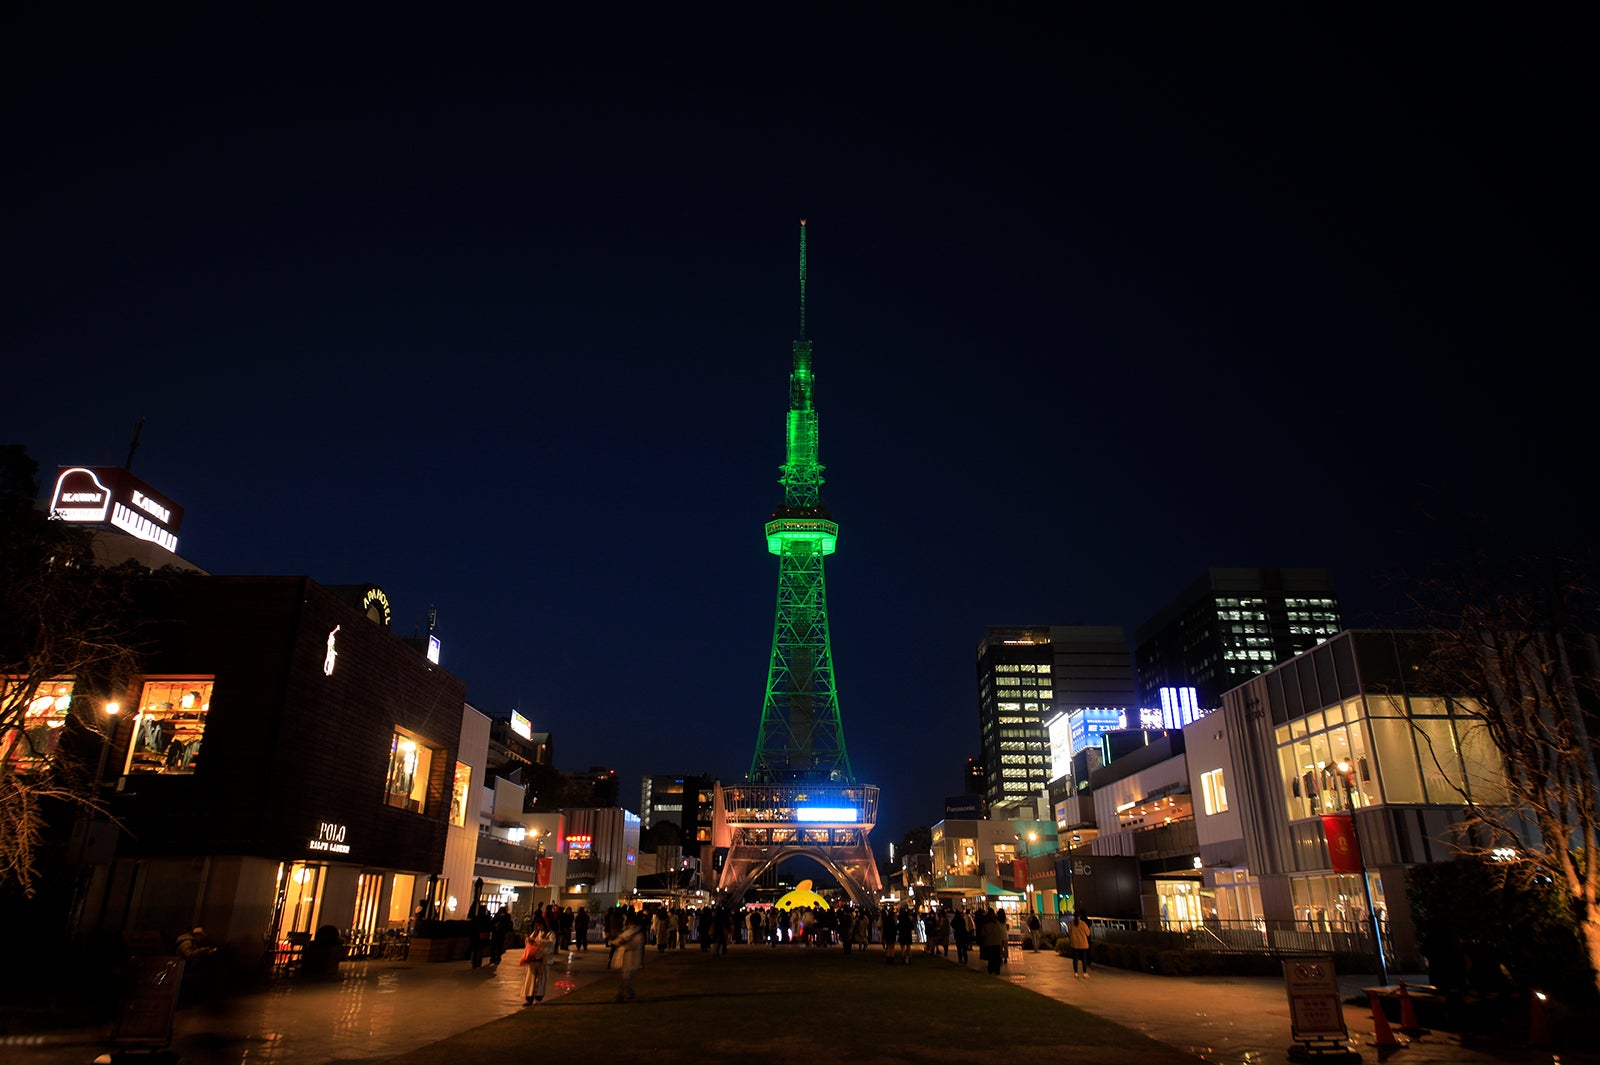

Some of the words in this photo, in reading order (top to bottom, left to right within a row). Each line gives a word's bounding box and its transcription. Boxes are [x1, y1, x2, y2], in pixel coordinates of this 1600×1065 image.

[61, 493, 102, 503] KAWAI
[132, 489, 171, 524] KAWAI
[319, 822, 346, 843] POLO
